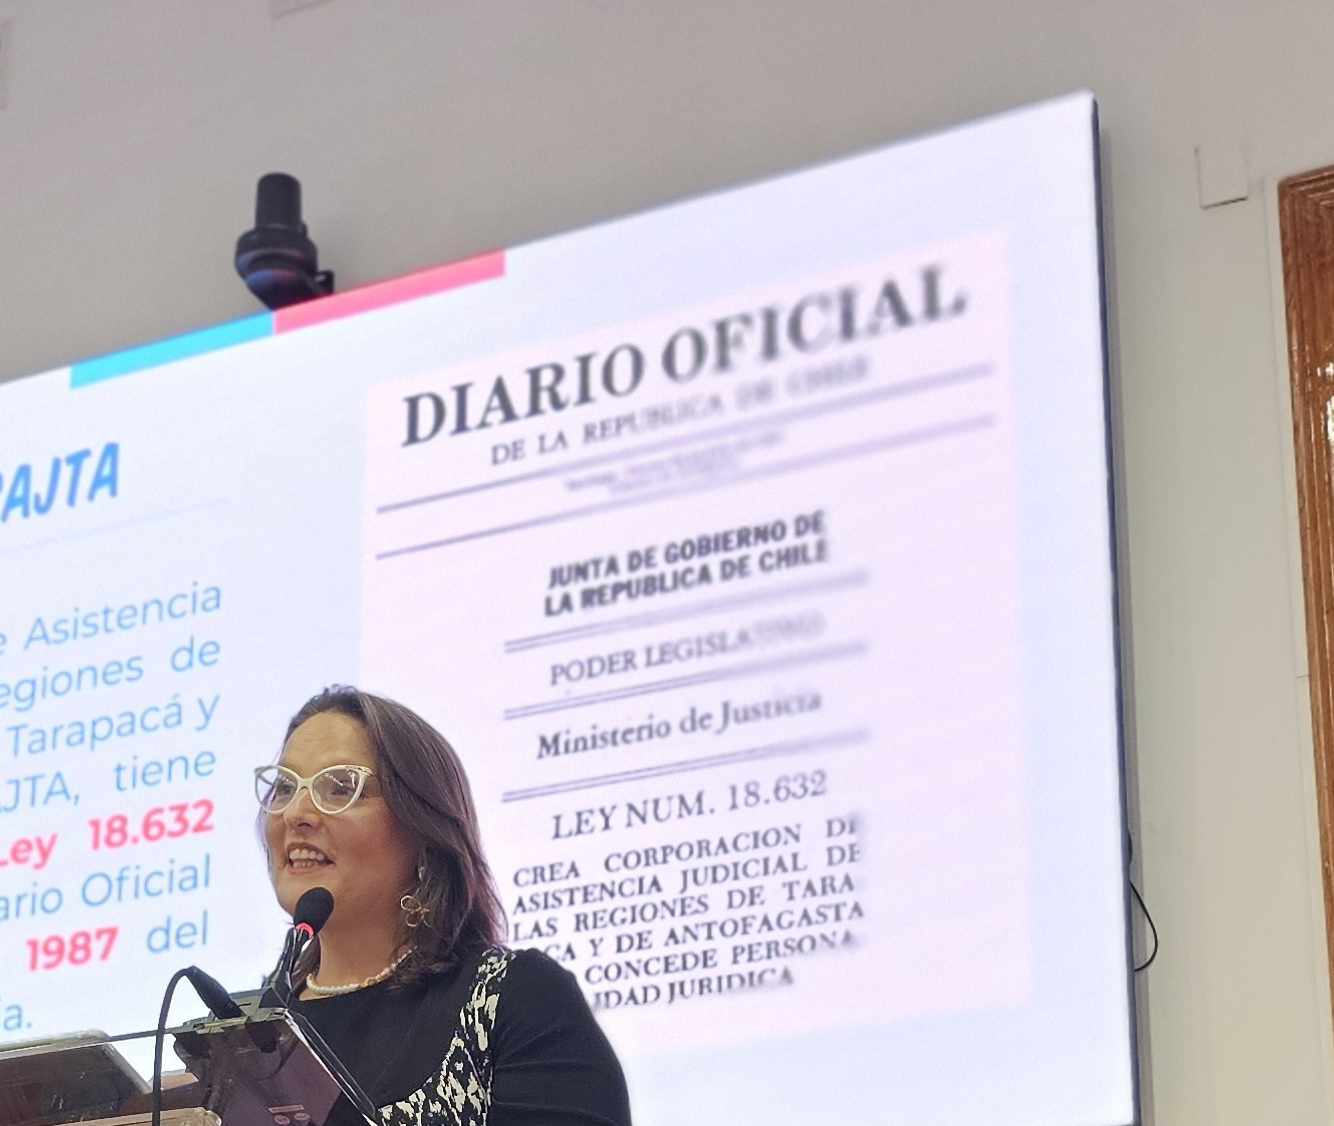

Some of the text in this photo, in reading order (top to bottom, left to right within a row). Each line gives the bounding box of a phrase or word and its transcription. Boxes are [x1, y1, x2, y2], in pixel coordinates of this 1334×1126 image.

[401, 264, 968, 448] DIARIO OFICIAL
[491, 438, 524, 466] DE
[539, 429, 568, 455] LA
[544, 538, 828, 618] LA REPUBLICA DE CHILE
[548, 508, 825, 590] JUNTA DE GOBIERNO DE
[24, 581, 221, 649] Asistencia
[171, 636, 220, 672] de
[551, 649, 638, 686] PODER
[5, 692, 183, 757] Tarapacá
[196, 692, 220, 732] y
[537, 691, 822, 760] Ministerio de Justicia
[114, 750, 216, 793] tiene
[88, 799, 214, 850] 18.632
[552, 769, 827, 840] LEY NUM. 18.632
[81, 853, 210, 907] Oficial
[512, 874, 663, 915] ASISTENCIA
[679, 851, 807, 894] JUDICIAL
[513, 860, 581, 887] CREA
[604, 824, 801, 873] CORPORACION
[26, 926, 118, 971] 1987
[147, 910, 208, 953] del
[513, 917, 558, 943] LAS
[574, 894, 709, 933] REGIONES
[727, 885, 765, 910] DE
[588, 937, 604, 957] Y
[615, 930, 653, 954] DE
[664, 901, 864, 947] ANTOFAGASTA
[584, 948, 718, 985] CONCEDE
[668, 966, 794, 1003] JURIDICA
